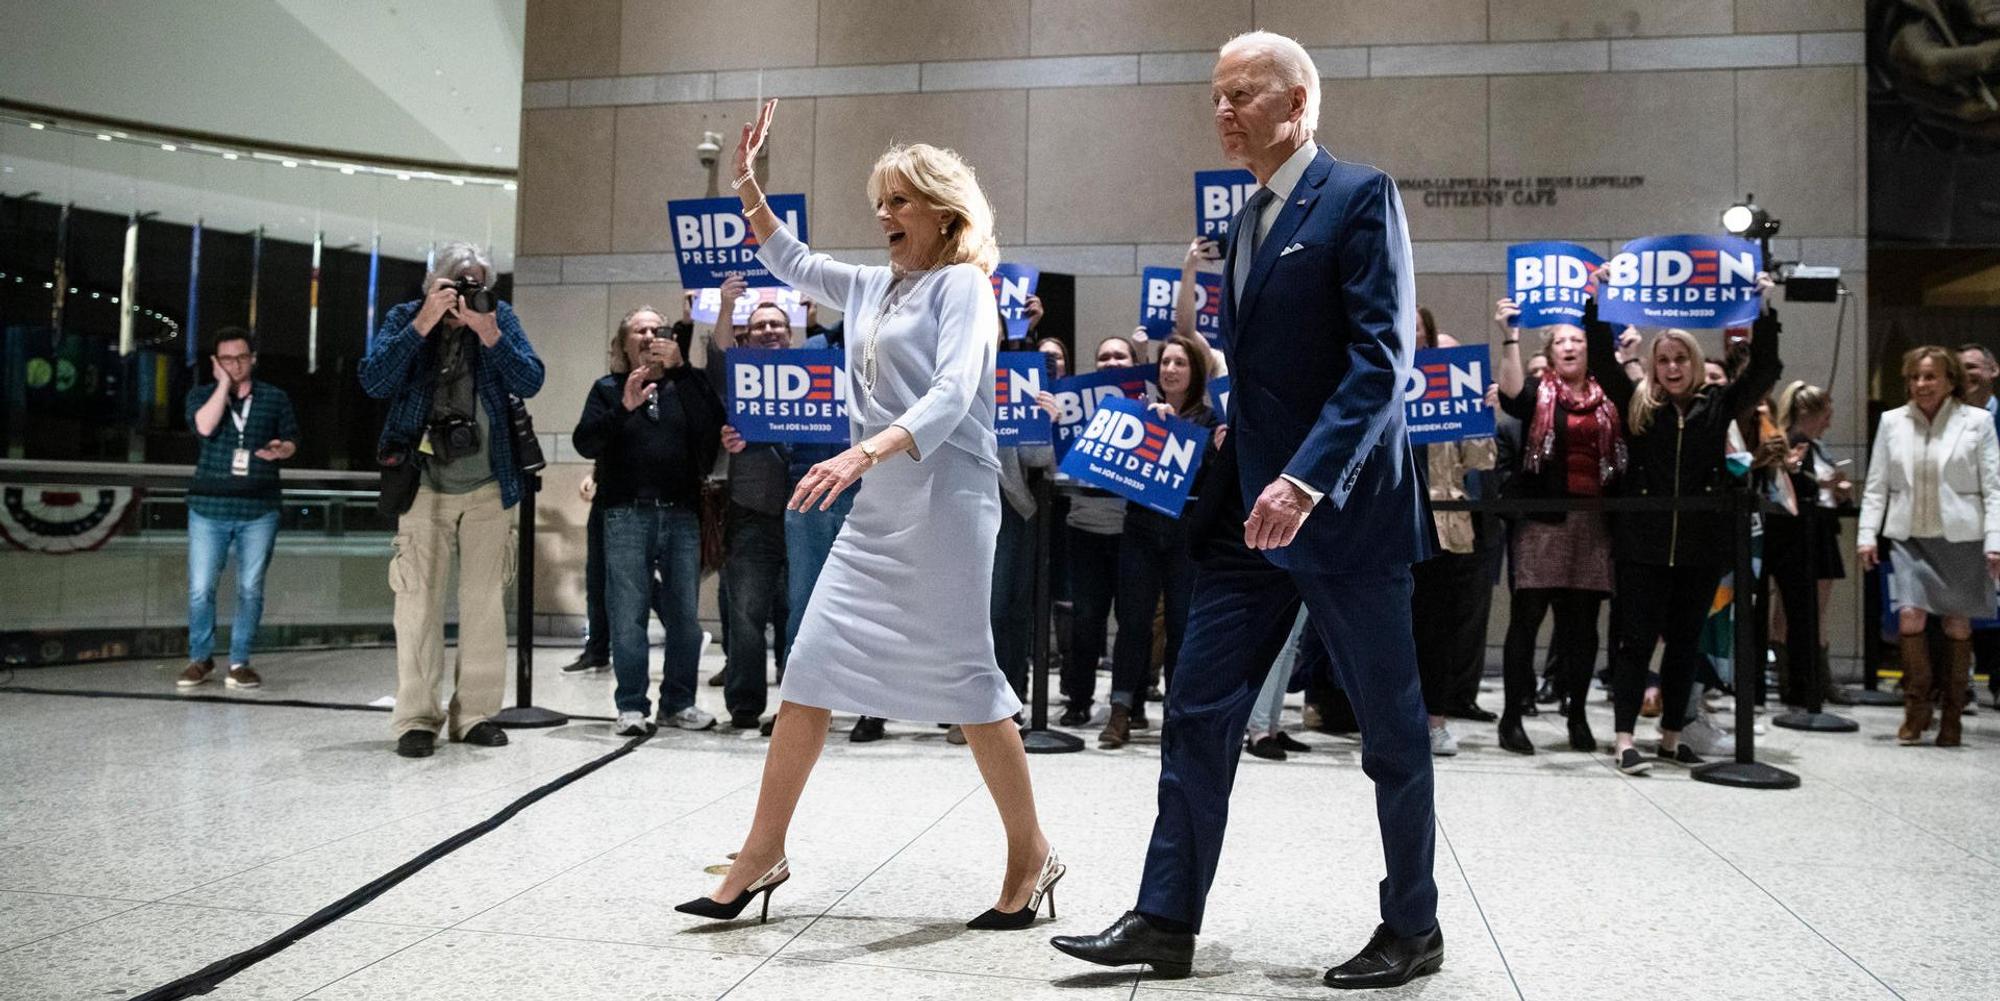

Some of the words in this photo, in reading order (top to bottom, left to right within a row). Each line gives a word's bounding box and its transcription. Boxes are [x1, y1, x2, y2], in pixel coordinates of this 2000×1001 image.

[682, 248, 754, 265] PRESID
[1608, 249, 1755, 287] BIDEN
[1148, 278, 1220, 313] BIDE
[1607, 286, 1754, 302] PRESIDENT
[1643, 308, 1661, 316] Text
[1662, 308, 1678, 317] JOE
[1679, 308, 1688, 316] to
[1688, 309, 1715, 317] 30330
[736, 401, 848, 417] PRESIDEN
[768, 422, 785, 431] Text
[785, 423, 800, 431] JOE
[809, 423, 831, 432] 30330
[1082, 408, 1196, 474] BIDEN
[1074, 438, 1185, 490] PRESIDENT
[1088, 463, 1102, 475] Text
[1102, 469, 1116, 481] JOE
